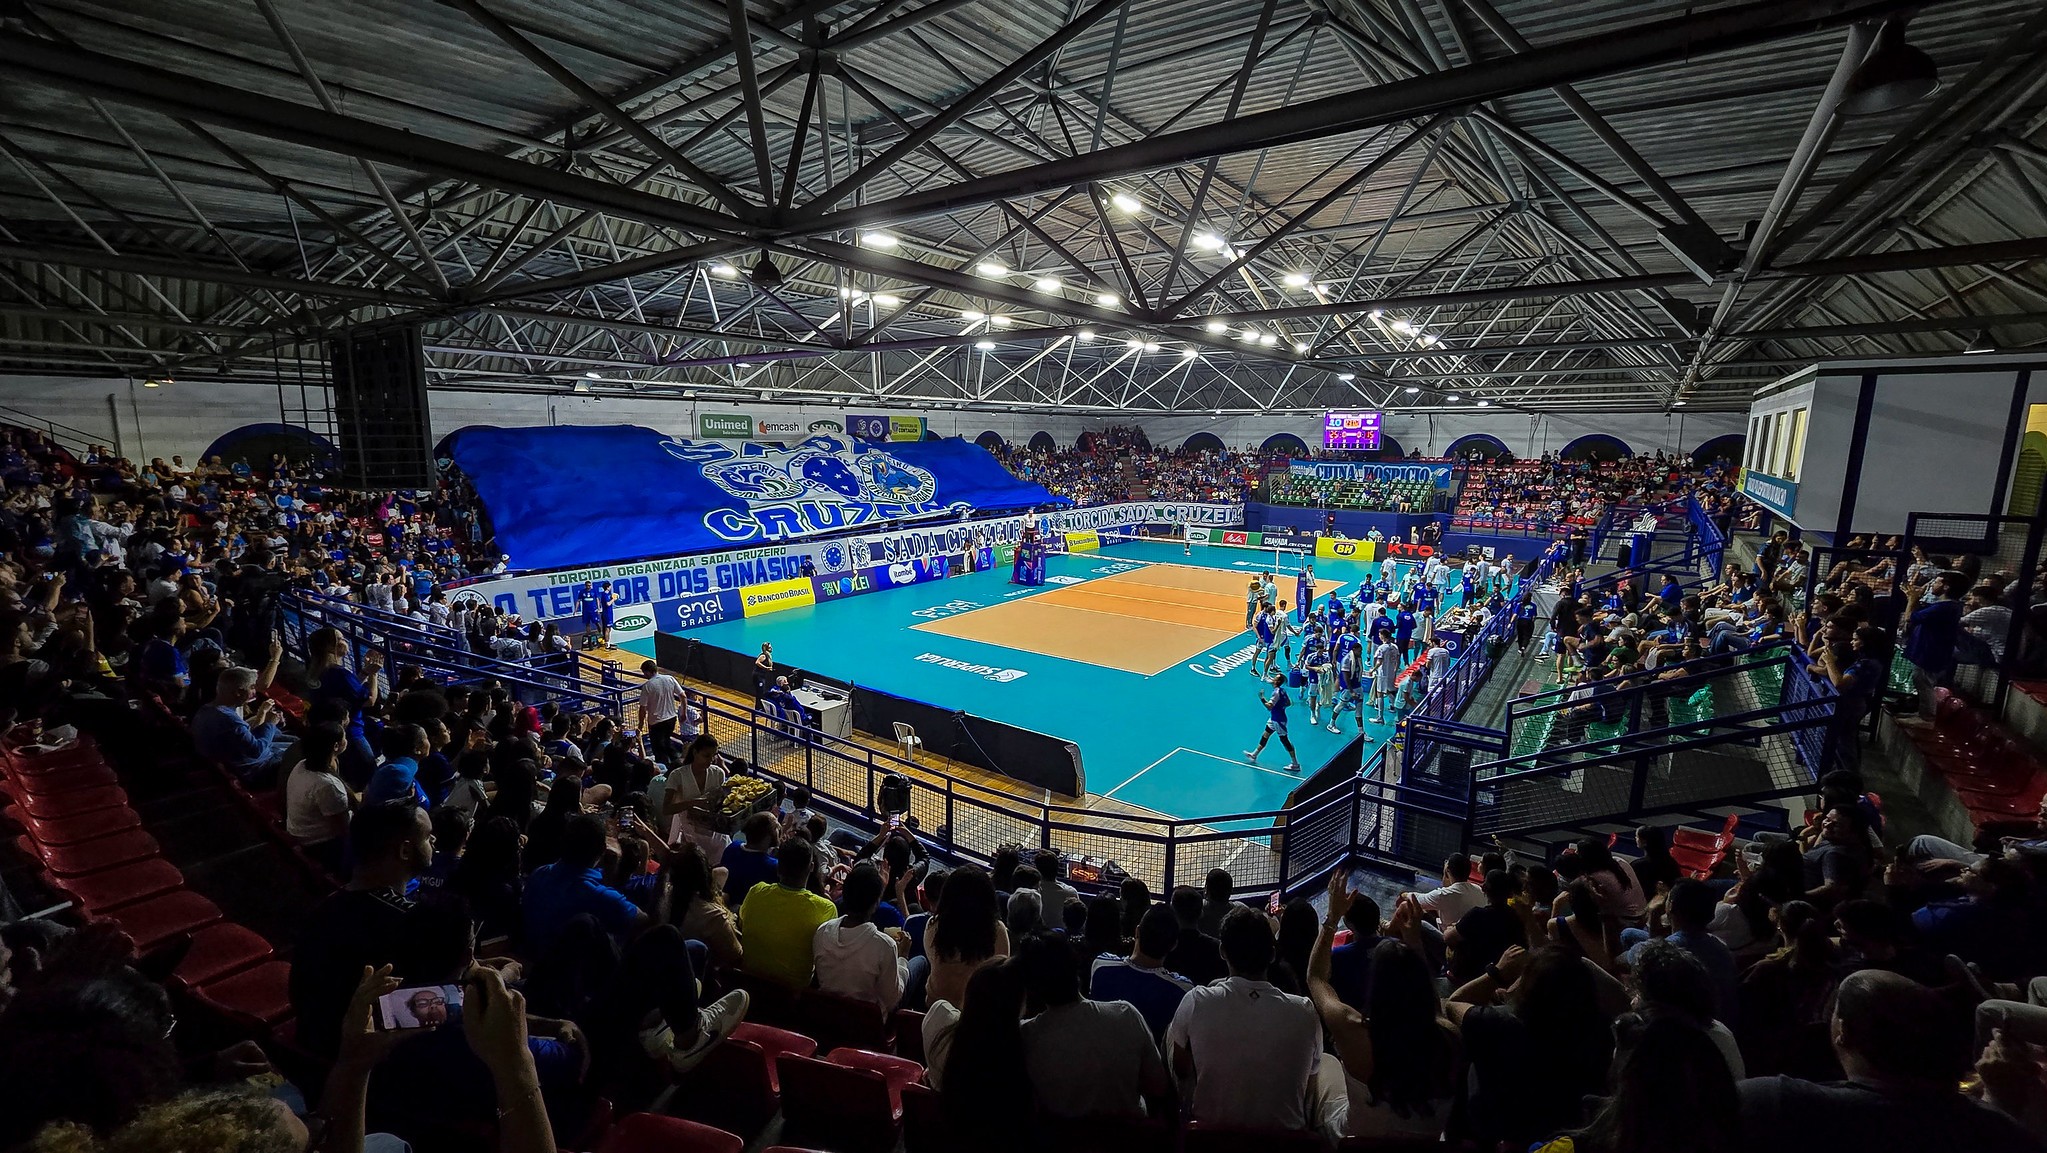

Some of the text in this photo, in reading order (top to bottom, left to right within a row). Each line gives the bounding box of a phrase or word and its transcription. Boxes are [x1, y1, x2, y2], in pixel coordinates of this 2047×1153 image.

[705, 418, 748, 430] Unimed
[766, 422, 800, 432] emcash
[1316, 464, 1357, 481] CHINA
[1066, 510, 1116, 532] TORCIDA
[1118, 504, 1158, 526] SADA
[882, 530, 940, 562] SADA
[946, 519, 1023, 554] CRUZEIR
[1336, 544, 1354, 554] BH
[1388, 543, 1434, 556] KTO
[548, 547, 787, 586] TORCIDA ORGANIZADA SADA CRUZEIRO
[658, 568, 708, 598] DOS
[757, 593, 780, 603] BANCO
[788, 588, 810, 598] BRASIL
[678, 594, 724, 619] enel
[615, 616, 648, 630] SADA
[681, 612, 724, 628] BRASIL
[914, 652, 1002, 674] SUPERLIGA
